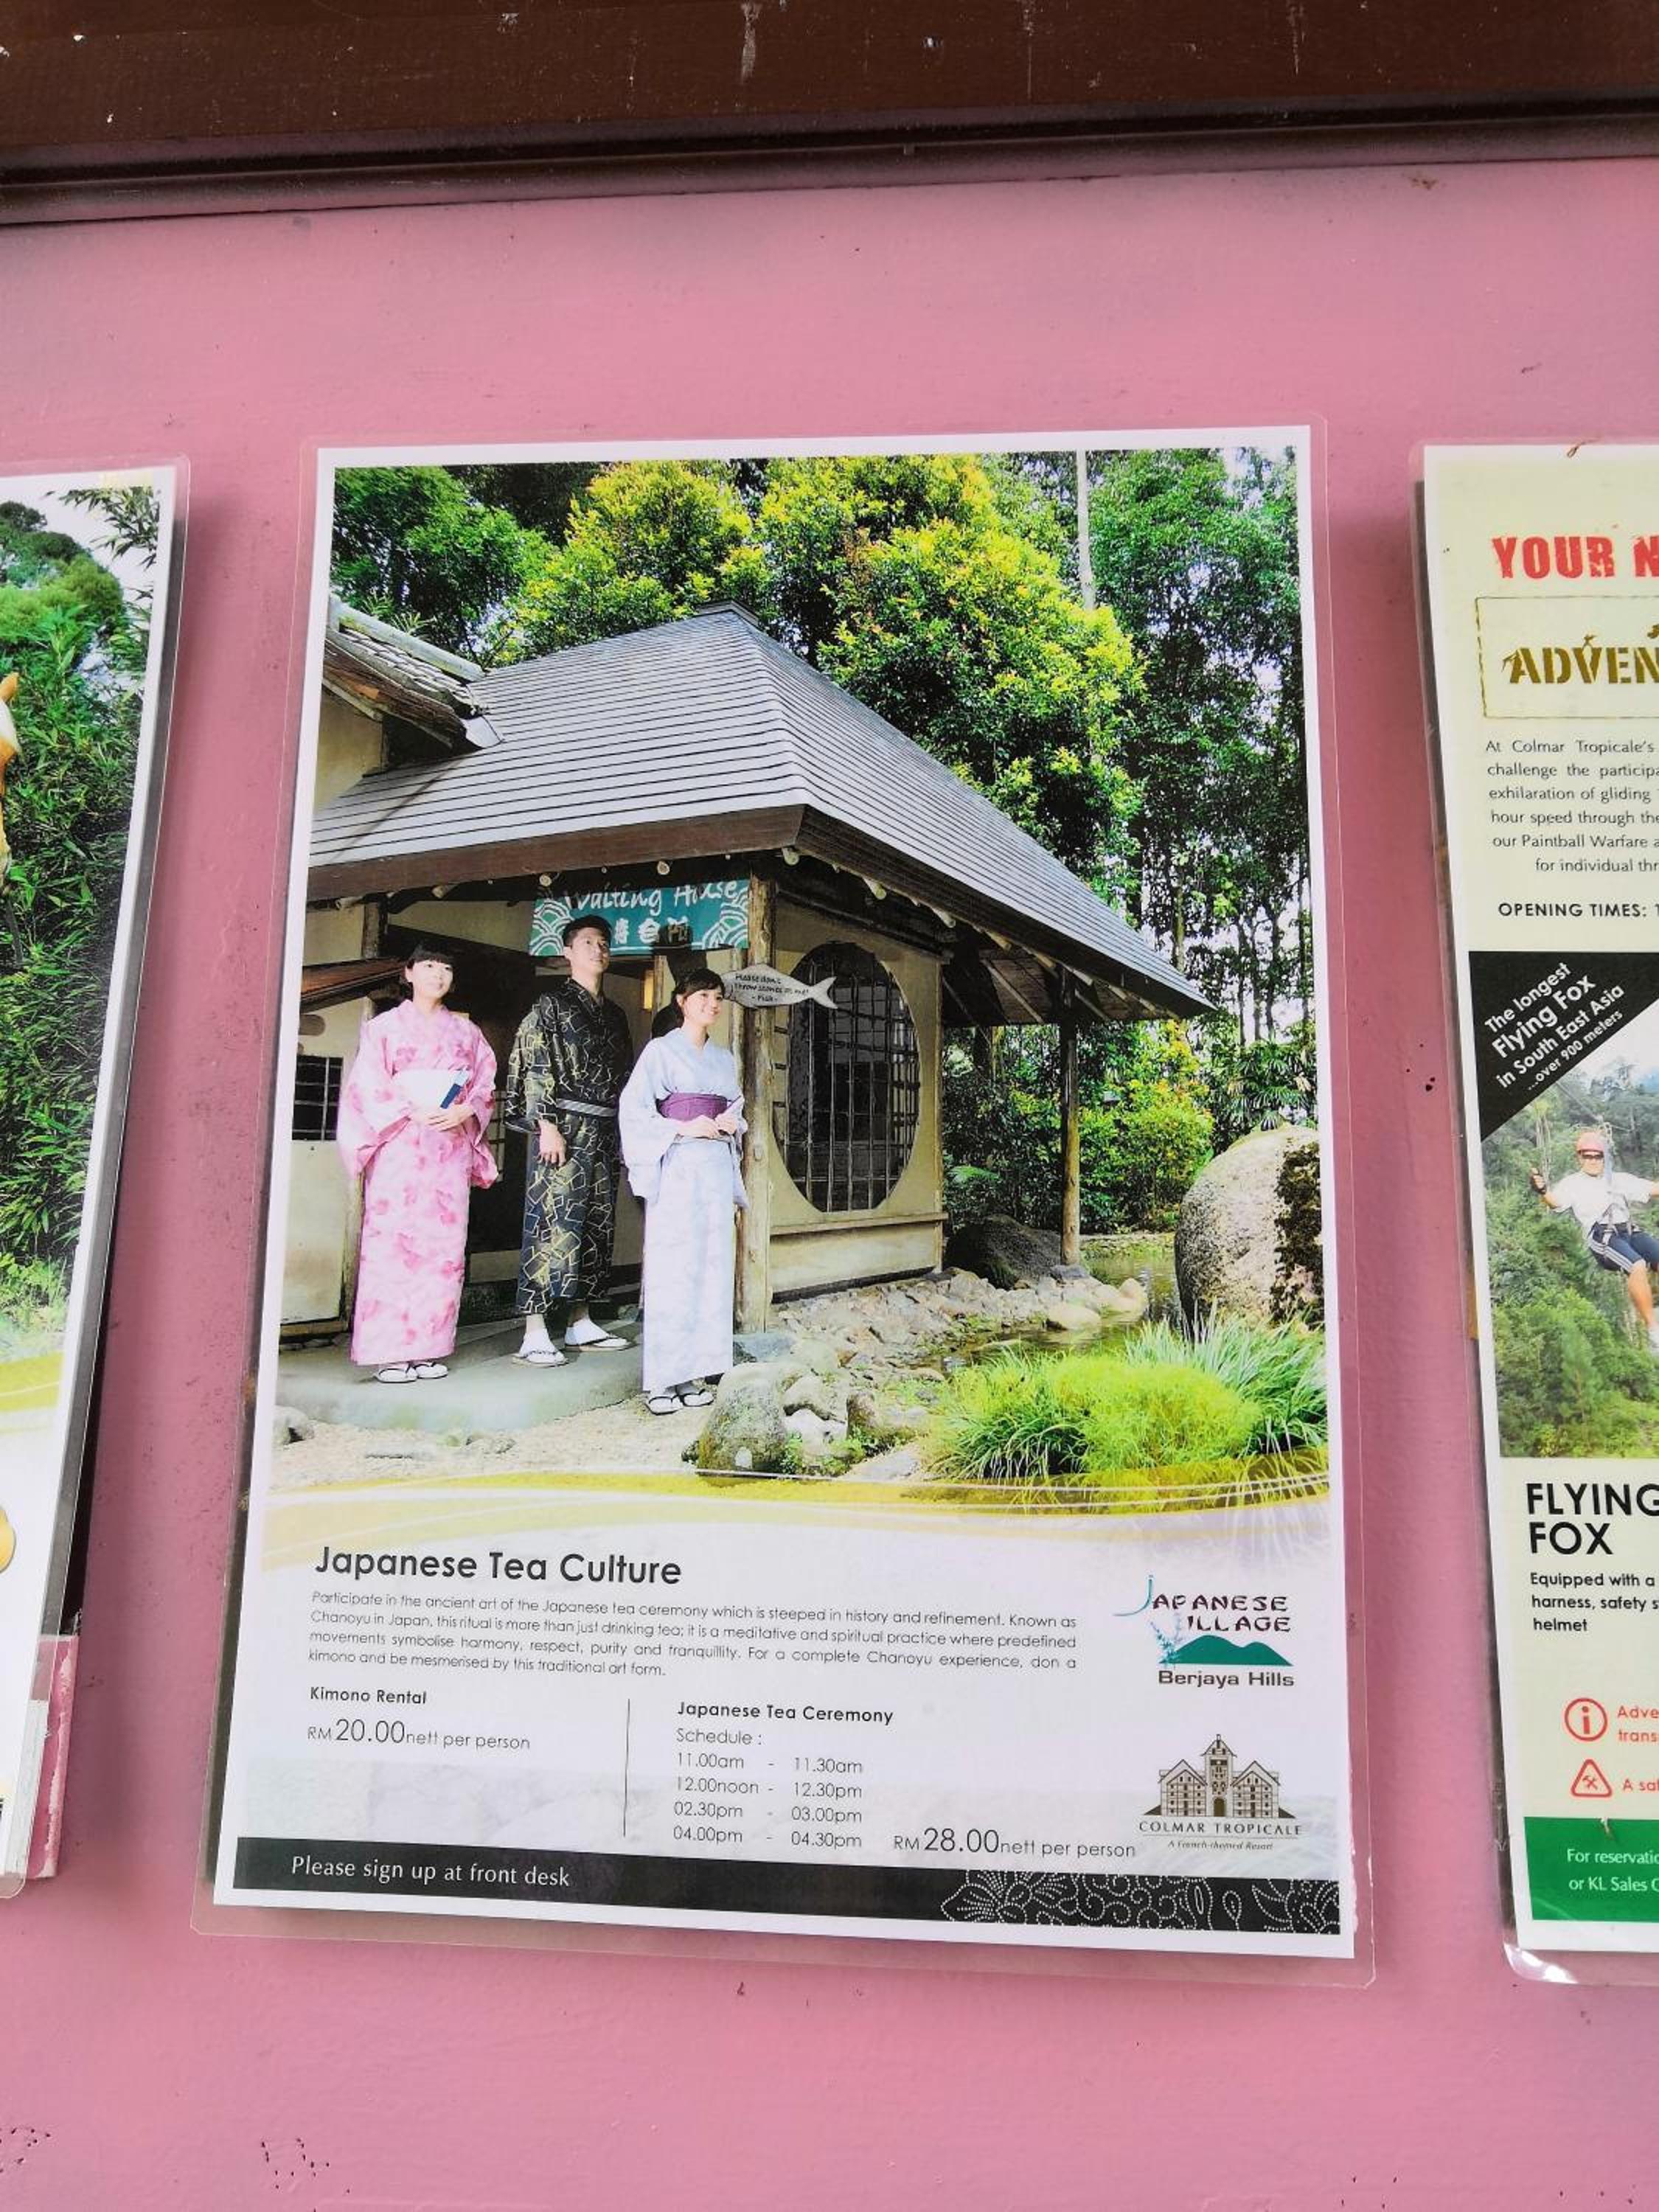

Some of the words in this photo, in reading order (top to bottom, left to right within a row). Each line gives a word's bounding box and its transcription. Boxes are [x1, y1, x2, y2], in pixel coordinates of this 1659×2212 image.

[1492, 537, 1615, 578] YOUR
[1486, 740, 1500, 752] At
[1512, 740, 1565, 752] Colmar
[1576, 740, 1655, 755] Tropicale's
[1488, 763, 1557, 779] challenge
[1567, 764, 1590, 776] the
[1489, 787, 1574, 800] exhilaration
[1580, 787, 1595, 799] of
[1601, 787, 1651, 804] gliding
[1492, 810, 1524, 824] hour
[1530, 810, 1572, 826] speed
[1578, 811, 1635, 827] through
[1641, 811, 1659, 824] the
[1492, 837, 1517, 847] our
[1522, 835, 1585, 847] Paintball
[1590, 835, 1648, 847] Warfare
[1536, 858, 1555, 871] for
[1561, 859, 1632, 872] individual
[1498, 903, 1582, 917] OPENING
[1590, 903, 1646, 917] TIMES:
[1484, 1009, 1515, 1032] The
[1513, 962, 1571, 1012] longest
[1492, 1006, 1558, 1058] Flying
[1552, 975, 1596, 1010] Fox
[1496, 1074, 1516, 1088] in
[1514, 1038, 1559, 1074] South
[1555, 1009, 1590, 1041] East
[1590, 985, 1624, 1015] Asia
[1561, 1040, 1582, 1060] 900
[1584, 1010, 1623, 1044] meters
[1526, 1483, 1659, 1516] FLYING
[1529, 1522, 1613, 1554] FOX
[316, 1546, 478, 1580] Japanese
[489, 1552, 547, 1582] Tea
[559, 1554, 682, 1585] Culture
[1531, 1573, 1604, 1588] Equipped
[1610, 1574, 1640, 1586] with
[1646, 1576, 1655, 1586] a
[1113, 1574, 1287, 1616] JAPANESE
[1531, 1595, 1596, 1610] harness,
[1601, 1596, 1646, 1612] safety
[312, 1590, 382, 1606] Participate
[400, 1596, 421, 1607] the
[425, 1597, 475, 1609] ancient
[479, 1599, 496, 1610] art
[501, 1599, 514, 1610] of
[518, 1599, 538, 1611] the
[542, 1600, 608, 1614] Japanese
[613, 1603, 634, 1614] tea
[639, 1605, 708, 1618] ceremony
[712, 1606, 753, 1618] which
[769, 1606, 825, 1624] steeped
[846, 1610, 888, 1624] history
[893, 1612, 921, 1623] and
[924, 1612, 1004, 1626] refinement.
[1009, 1614, 1056, 1627] Known
[1061, 1617, 1076, 1628] as
[310, 1611, 370, 1624] Chanoyu
[437, 1616, 457, 1627] this
[459, 1617, 491, 1629] ritual
[507, 1621, 540, 1631] more
[544, 1618, 574, 1632] than
[577, 1623, 597, 1635] just
[602, 1624, 653, 1637] drinking
[658, 1625, 684, 1637] tea;
[723, 1627, 796, 1641] meditative
[801, 1629, 827, 1641] and
[832, 1630, 883, 1644] spiritual
[887, 1632, 945, 1645] practice
[950, 1634, 993, 1646] where
[998, 1635, 1076, 1649] predefined
[1534, 1618, 1587, 1631] helmet
[310, 1632, 386, 1644] movements
[392, 1636, 454, 1647] symbolise
[461, 1637, 523, 1651] harmony,
[530, 1641, 582, 1654] respect,
[591, 1642, 627, 1657] purity
[634, 1644, 661, 1656] and
[669, 1644, 740, 1661] tranquillity.
[748, 1647, 768, 1660] For
[776, 1651, 785, 1660] a
[792, 1649, 860, 1663] complete
[867, 1652, 932, 1666] Chanoyu
[939, 1655, 1023, 1669] experience,
[1032, 1656, 1060, 1669] don
[1067, 1659, 1076, 1669] a
[308, 1649, 355, 1662] kimono
[360, 1652, 385, 1663] and
[391, 1653, 406, 1664] be
[411, 1654, 488, 1668] mesmerised
[493, 1656, 508, 1670] by
[514, 1657, 534, 1669] this
[538, 1658, 605, 1672] traditional
[609, 1663, 626, 1674] art
[631, 1663, 666, 1676] form.
[1159, 1670, 1239, 1688] Berjaya
[1249, 1672, 1294, 1686] Hills
[310, 1687, 370, 1702] Kimono
[376, 1689, 427, 1705] Rental
[678, 1702, 760, 1720] Japanese
[767, 1705, 796, 1719] Tea
[803, 1705, 894, 1725] Ceremony
[444, 1733, 470, 1748] per
[476, 1735, 530, 1750] person
[678, 1752, 745, 1768] 11.00am
[794, 1758, 863, 1773] 11.30am
[678, 1776, 759, 1794] 12.00noon
[794, 1782, 863, 1800] 12.30pm
[1623, 1780, 1632, 1790] A
[675, 1801, 742, 1819] 02.30pm
[792, 1806, 862, 1824] 03.00pm
[673, 1825, 742, 1844] 04.00pm
[791, 1832, 862, 1848] 04.30pm
[1140, 1821, 1205, 1832] COLMAR
[1215, 1823, 1301, 1835] TROPICALE
[1042, 1840, 1071, 1857] per
[1077, 1843, 1135, 1860] person
[1246, 1842, 1273, 1850] Resort
[1567, 1848, 1590, 1863] For
[292, 1855, 355, 1877] Please
[364, 1860, 403, 1884] sign
[412, 1866, 436, 1885] up
[445, 1864, 462, 1880] at
[470, 1865, 517, 1884] front
[525, 1866, 570, 1887] desk
[1568, 1879, 1584, 1890] or
[1589, 1877, 1607, 1891] KL
[1611, 1877, 1647, 1891] Sales
